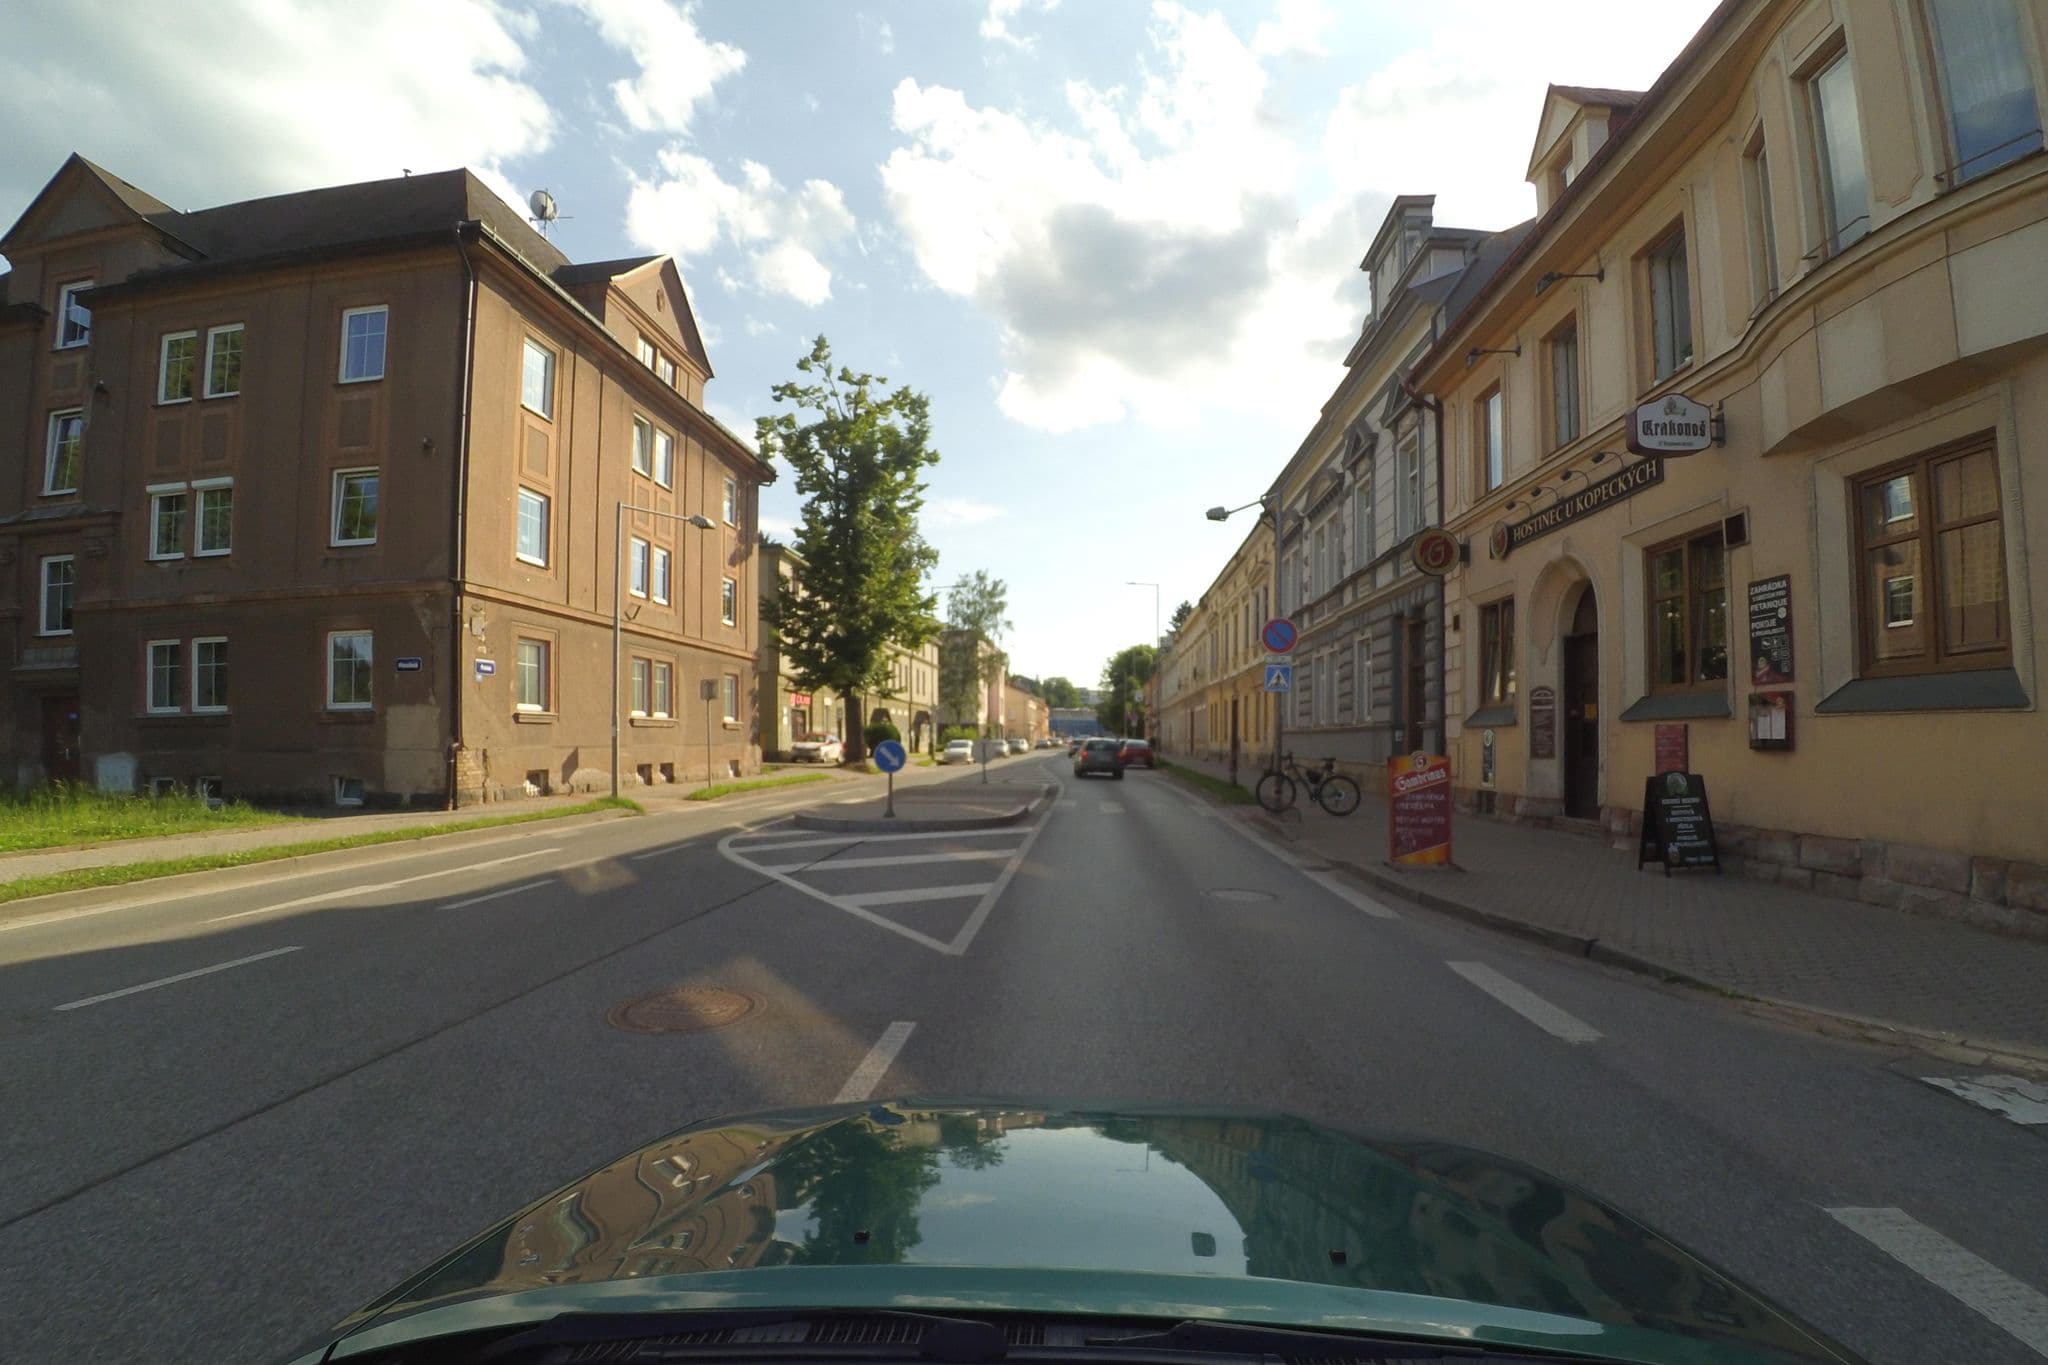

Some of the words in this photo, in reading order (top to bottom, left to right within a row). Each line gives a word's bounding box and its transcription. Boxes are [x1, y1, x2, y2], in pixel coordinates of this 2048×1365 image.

[1642, 420, 1706, 437] Krakonoš
[1513, 509, 1563, 542] HOSTINEC
[1565, 501, 1574, 518] U
[1576, 459, 1658, 513] KOPECKÝCH
[1750, 598, 1788, 612] PETANQUE
[1394, 768, 1446, 790] Gambrinus
